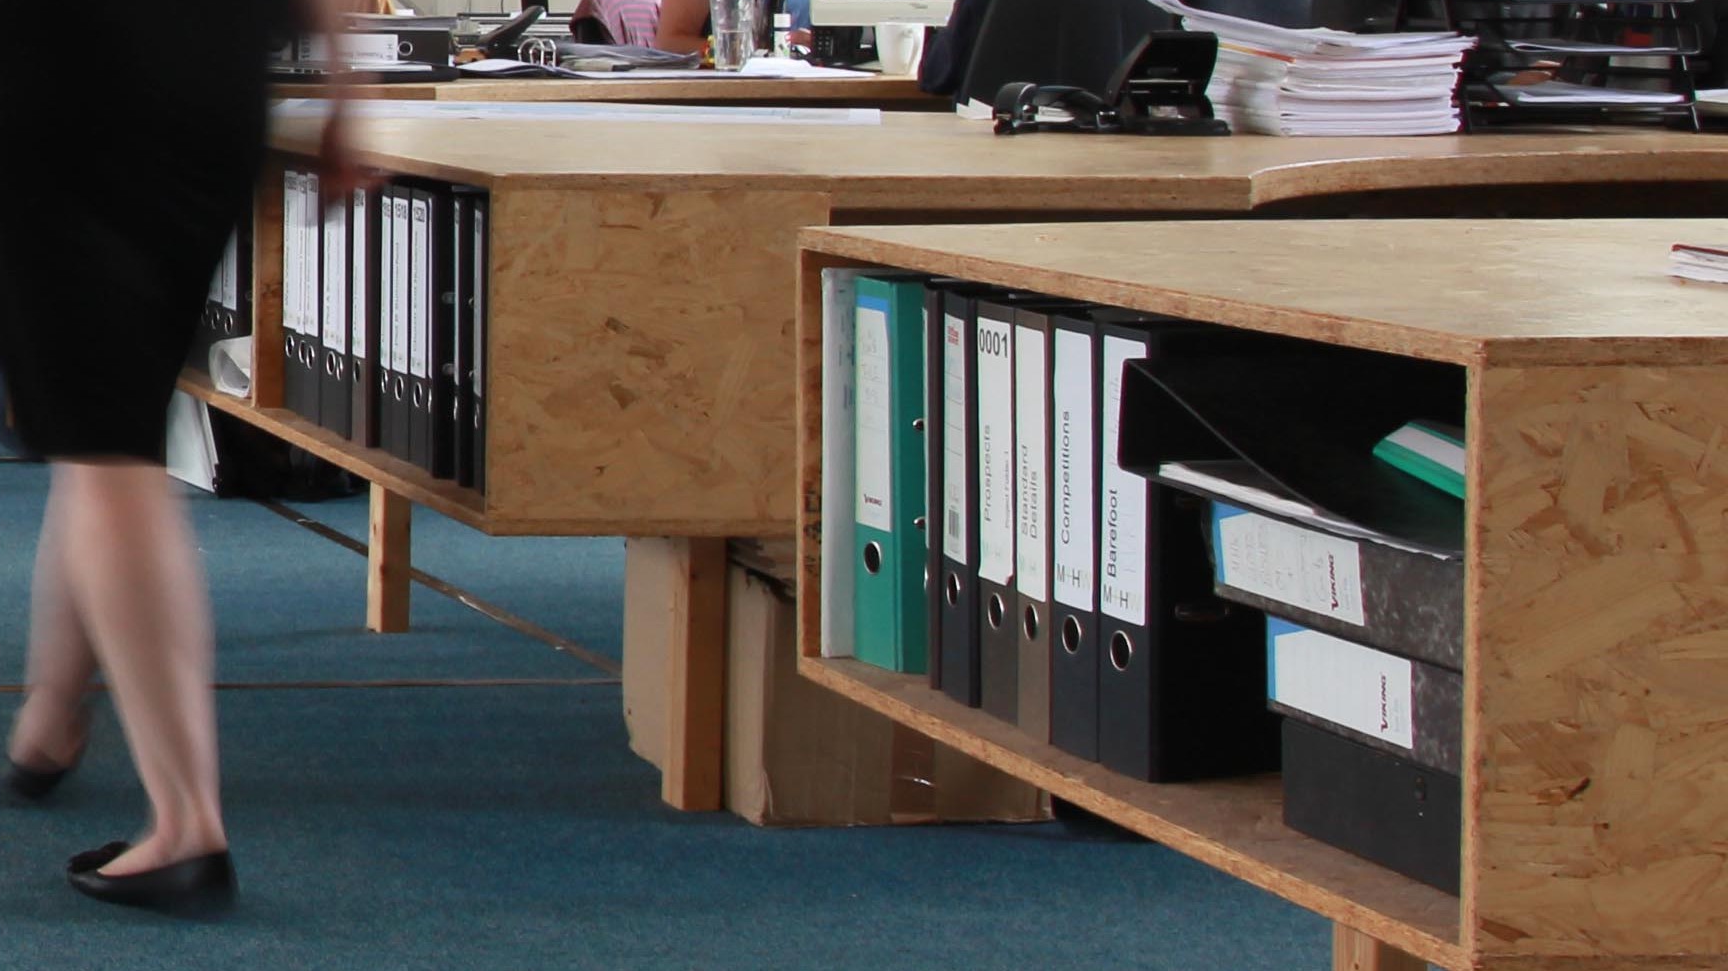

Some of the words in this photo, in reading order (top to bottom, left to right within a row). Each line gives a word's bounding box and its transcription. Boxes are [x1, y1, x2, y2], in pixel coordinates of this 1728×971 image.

[978, 329, 1009, 359] 0001
[984, 425, 992, 522] Prospects
[1020, 444, 1029, 536] Standard
[1029, 471, 1038, 540] Details
[1061, 410, 1070, 545] Competitions
[1106, 489, 1118, 578] Barefoot
[1328, 554, 1340, 611] VIKING
[1380, 674, 1388, 733] VIKING
